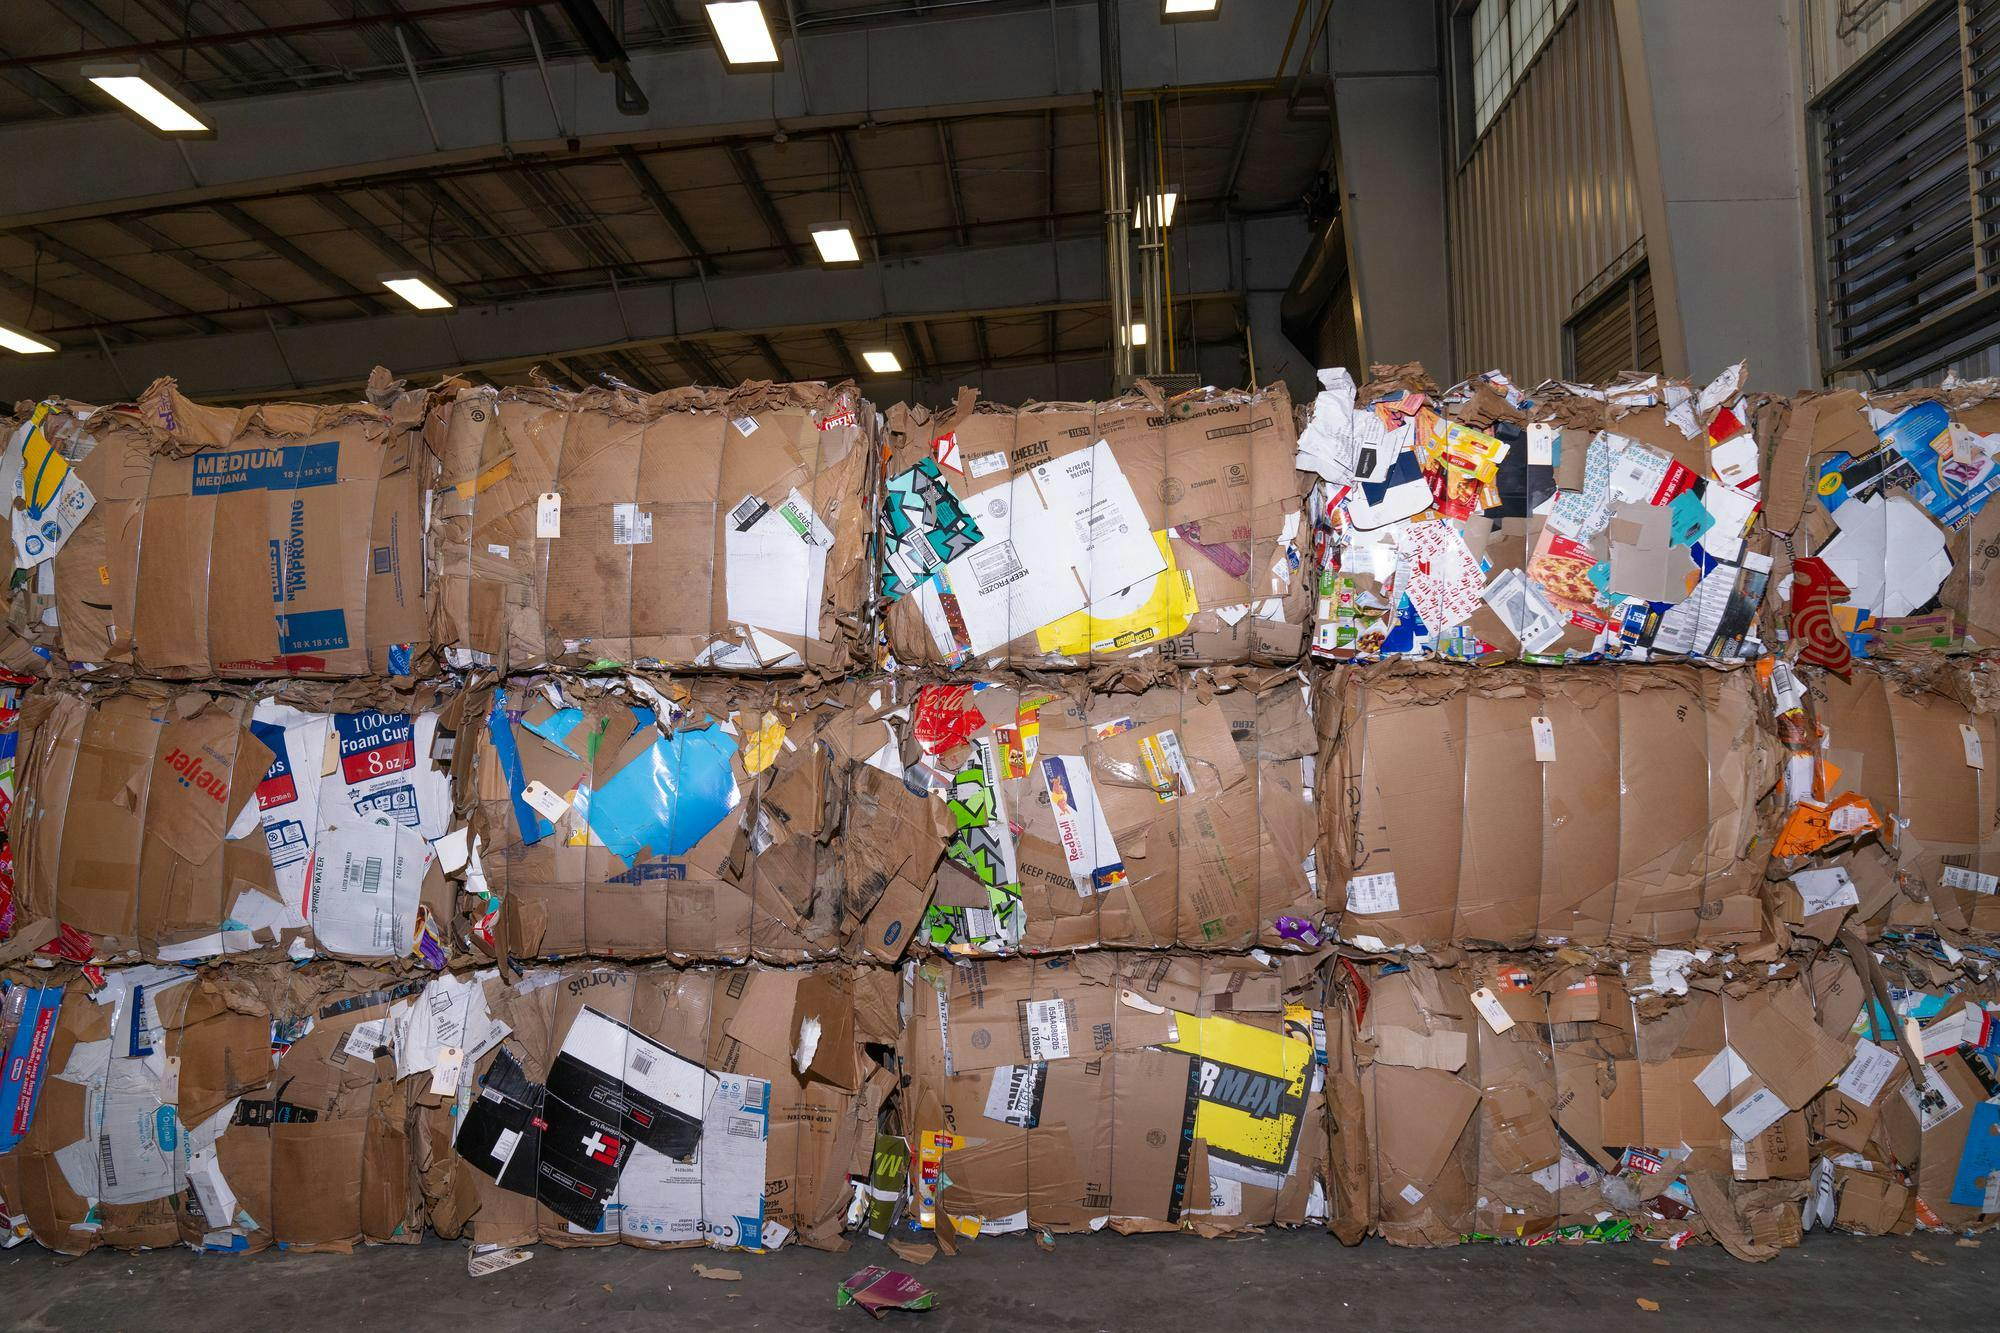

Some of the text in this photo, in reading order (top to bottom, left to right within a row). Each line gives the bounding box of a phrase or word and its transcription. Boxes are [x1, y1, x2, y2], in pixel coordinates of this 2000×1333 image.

[1206, 404, 1240, 417] toasty
[198, 450, 284, 474] MEDIUM
[196, 473, 247, 486] MEDIANA
[787, 501, 812, 528] CELSIUS
[290, 500, 306, 592] IMPROVING
[978, 568, 1030, 596] KEEP FROZEN
[334, 637, 344, 645] 16
[1114, 632, 1136, 648] DOUGH
[1133, 628, 1154, 642] FRESH
[1232, 720, 1254, 728] ZERO
[341, 726, 410, 754] Foam Cups
[368, 752, 401, 774] 8 oz
[165, 747, 229, 806] meijer
[1060, 820, 1080, 862] Red Bull
[1020, 862, 1044, 878] KEEP
[311, 856, 324, 914] SPRING WATER
[162, 1116, 170, 1142] Original
[696, 1221, 734, 1238] core
